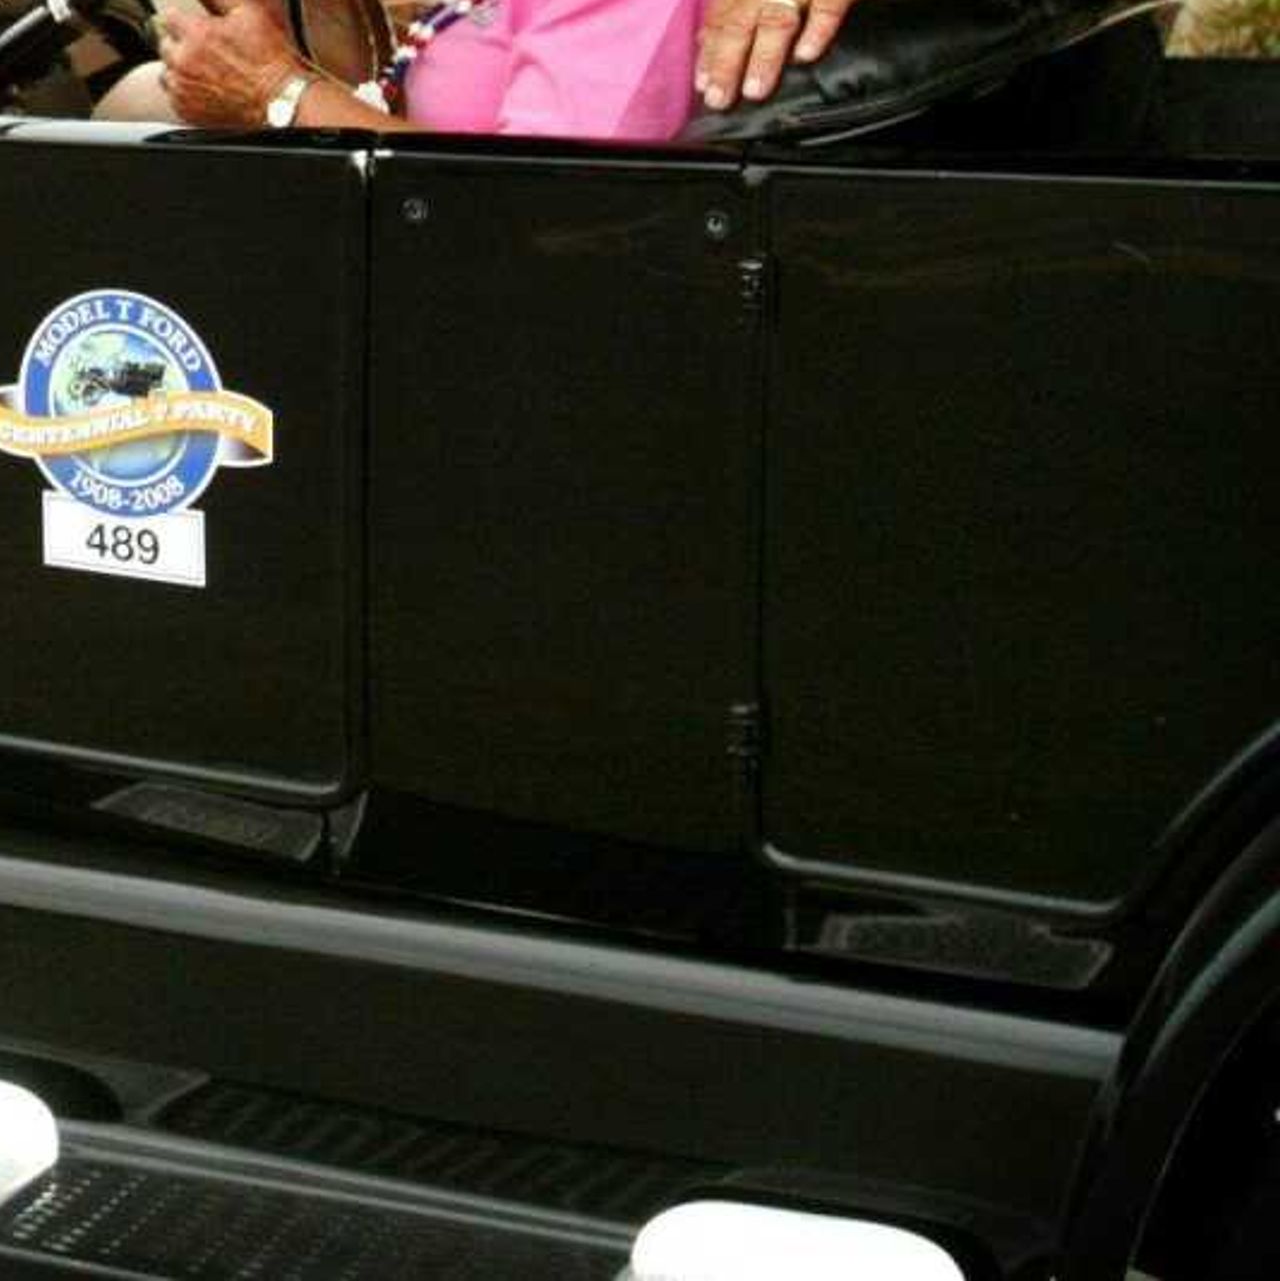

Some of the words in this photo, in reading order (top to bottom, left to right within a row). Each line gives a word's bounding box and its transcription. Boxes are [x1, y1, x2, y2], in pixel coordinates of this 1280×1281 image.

[34, 300, 111, 369] MODEL
[115, 298, 134, 324] T
[140, 306, 204, 373] FORD
[70, 470, 185, 509] 1908-2008
[85, 523, 161, 566] 489
